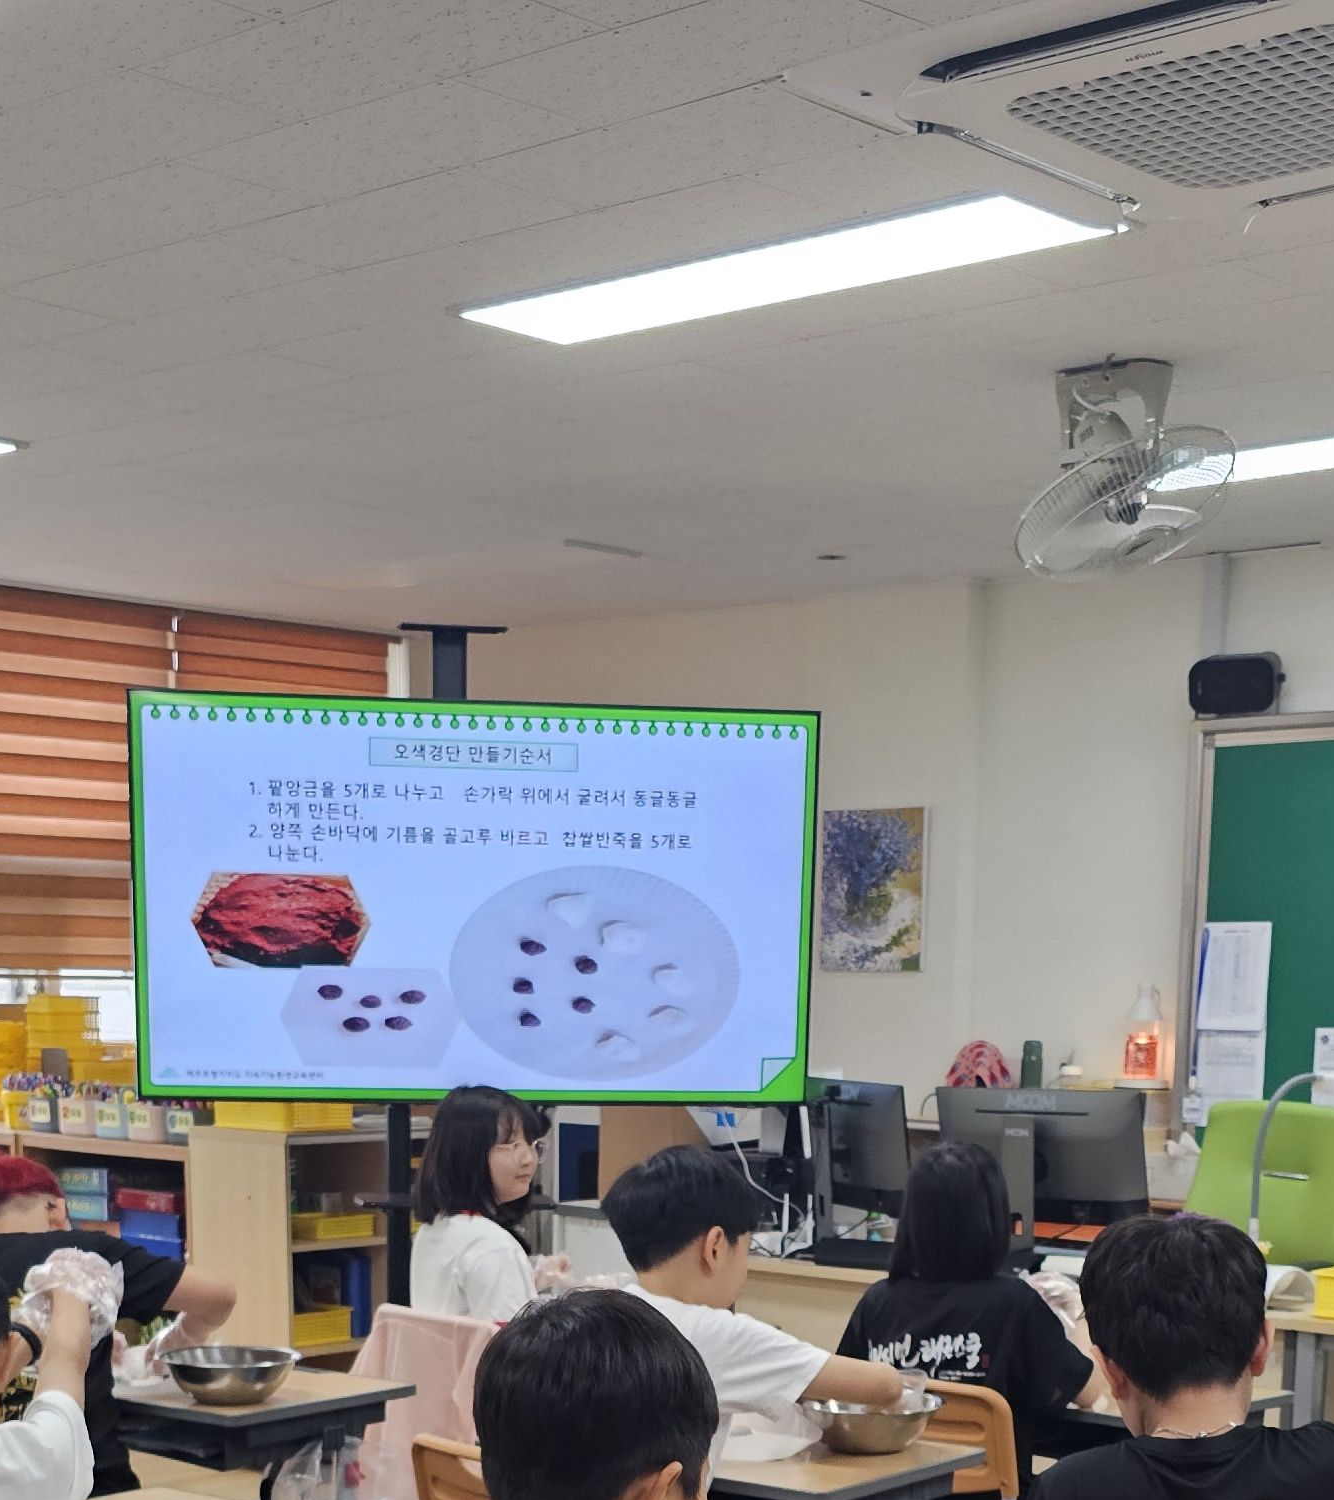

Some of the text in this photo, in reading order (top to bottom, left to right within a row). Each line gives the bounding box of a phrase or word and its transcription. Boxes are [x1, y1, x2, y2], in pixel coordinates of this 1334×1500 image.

[394, 743, 552, 765] 오색경단 만들기순서
[248, 779, 697, 809] 1. 팥앙금을 5개로 나누고 손가락 위에서 굴려서 동글동글
[268, 801, 364, 821] 하게 만든다.
[269, 822, 304, 841] 양쪽
[310, 823, 378, 843] 손바닥에
[386, 825, 436, 845] 기름을
[443, 826, 493, 846] 골고루
[499, 828, 549, 847] 바르고
[562, 830, 643, 850] 찹쌀반죽을
[651, 833, 692, 851] 5개로
[268, 844, 324, 863] 나눈다.
